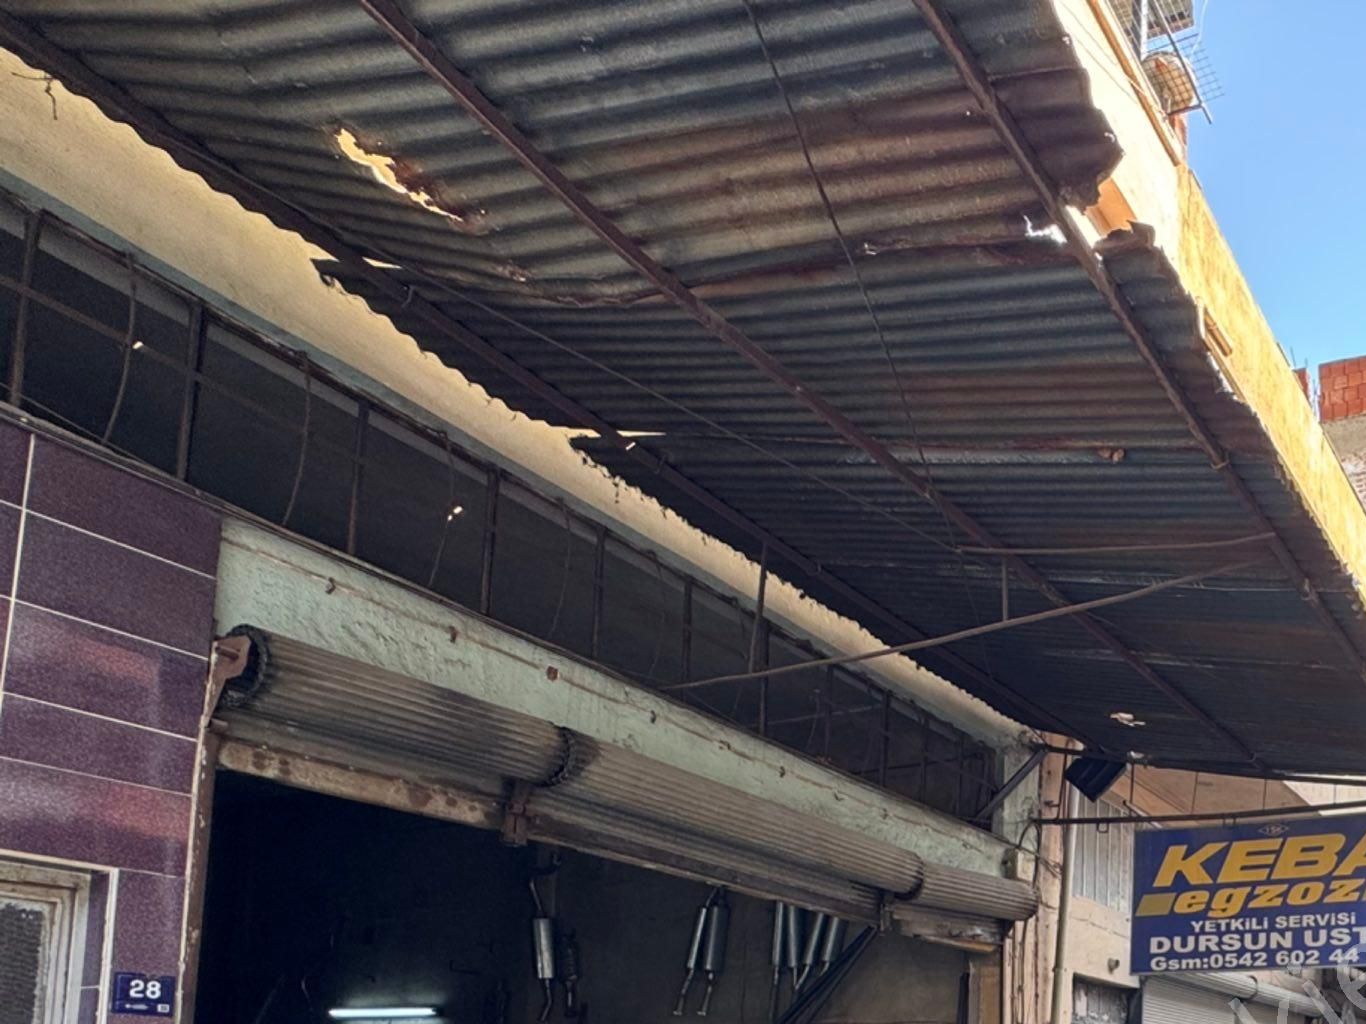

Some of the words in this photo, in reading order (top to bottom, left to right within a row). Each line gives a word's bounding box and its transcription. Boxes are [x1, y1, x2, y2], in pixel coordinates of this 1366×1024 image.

[1173, 878, 1366, 918] egzoz
[1150, 931, 1294, 954] DURSUN
[1150, 951, 1268, 971] Gsm:0542
[1275, 949, 1321, 966] 602
[1328, 948, 1360, 963] 44
[129, 979, 161, 999] 28
